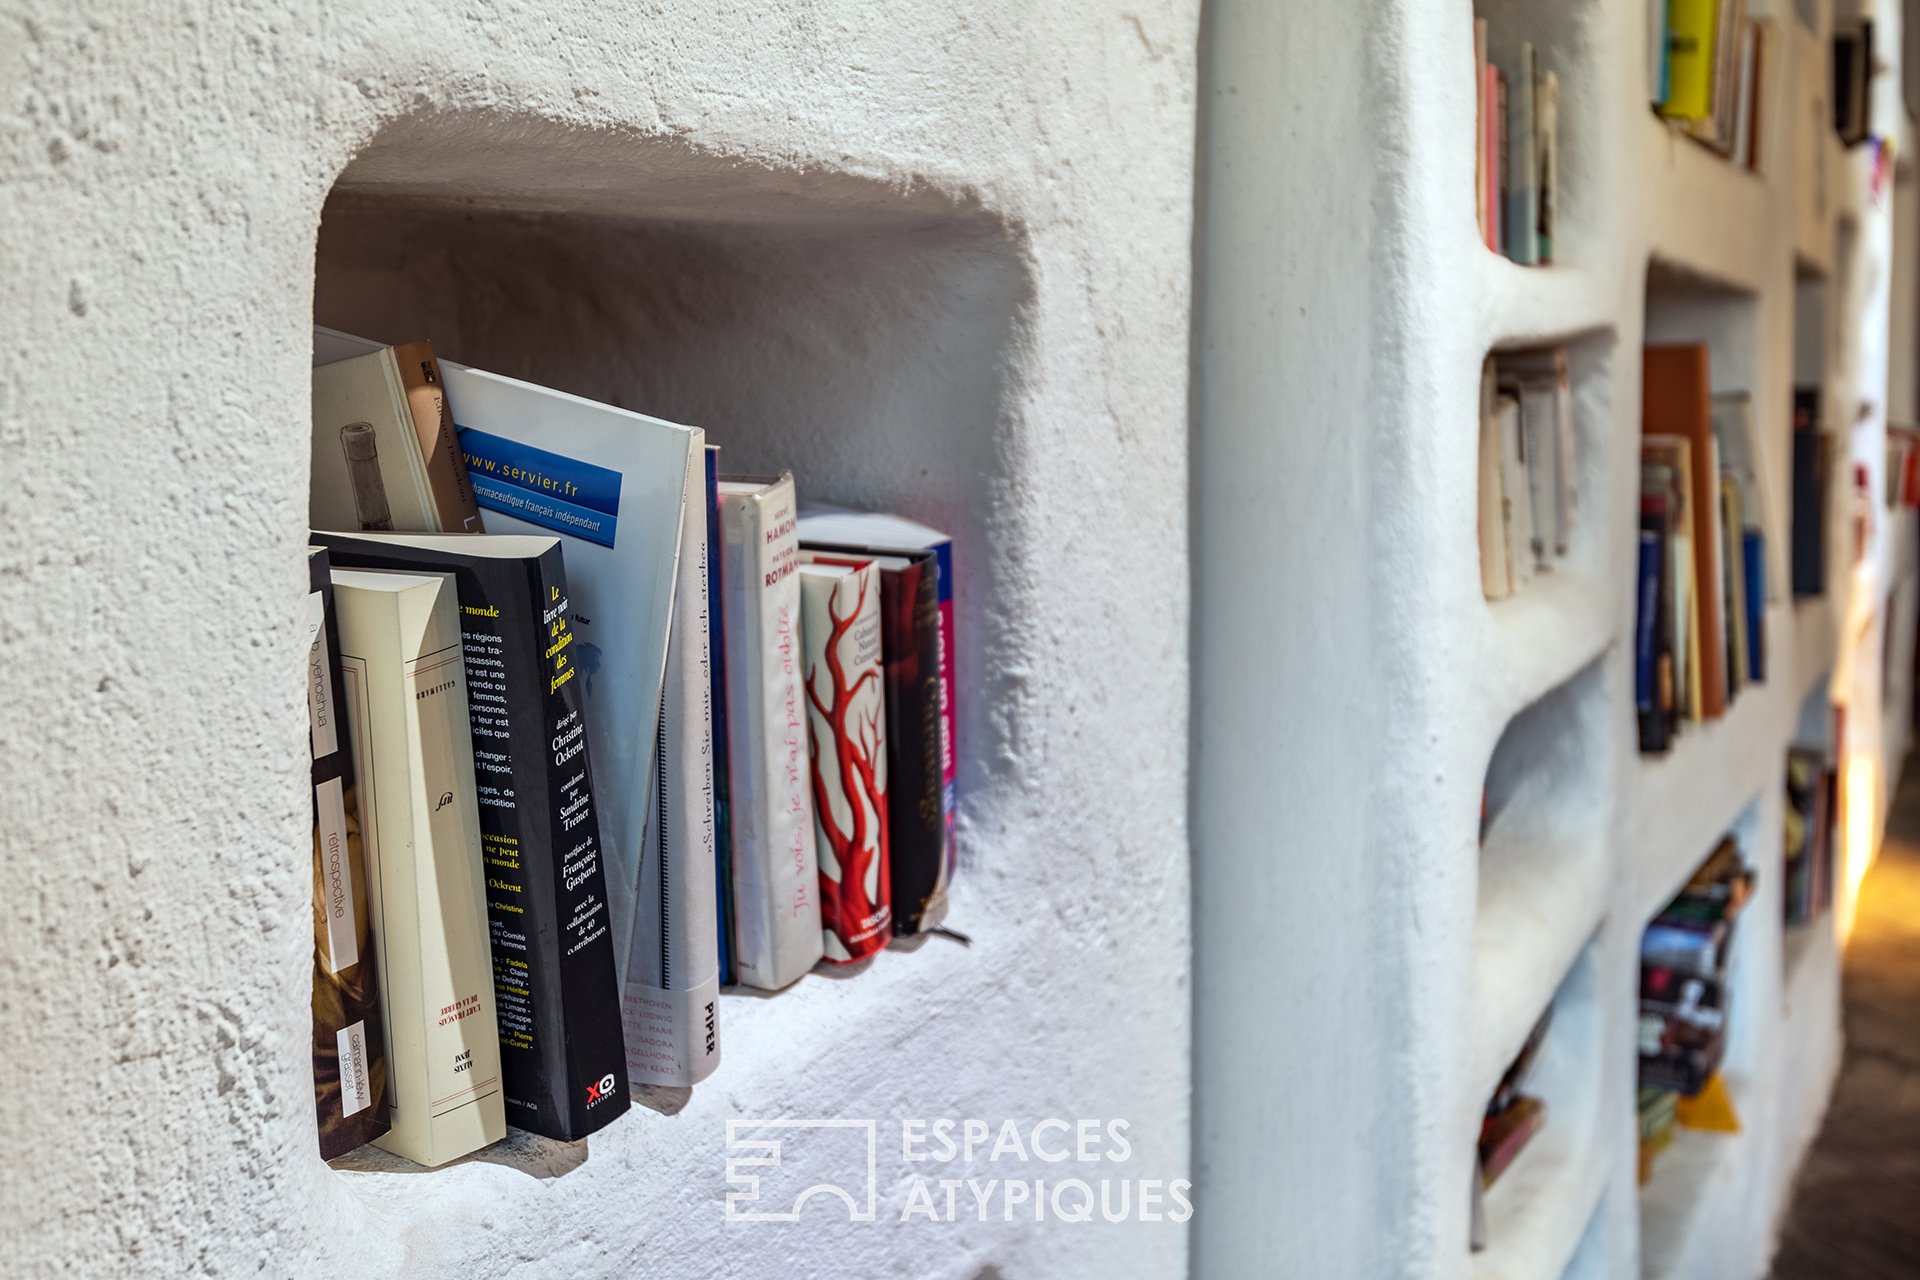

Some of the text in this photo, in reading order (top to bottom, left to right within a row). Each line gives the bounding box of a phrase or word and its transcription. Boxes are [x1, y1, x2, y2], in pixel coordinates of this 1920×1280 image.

[472, 484, 600, 532] harmaceutique français indépendant
[766, 516, 796, 544] HAMON
[772, 546, 794, 564] PATRICK
[765, 558, 800, 588] ROTMAN
[551, 586, 560, 601] Le
[465, 604, 500, 618] monde
[543, 596, 568, 624] livre noir
[551, 621, 559, 638] de
[559, 616, 566, 631] la
[700, 609, 708, 634] ich
[472, 632, 502, 643] régions
[778, 604, 793, 675] oublié
[545, 632, 573, 659] condition
[556, 653, 567, 670] des
[700, 643, 709, 678] oder
[475, 669, 488, 678] est
[490, 671, 505, 679] une
[550, 666, 575, 695] femmes
[416, 680, 456, 700] GALLIMARD
[468, 680, 494, 690] vende
[310, 658, 328, 728] yehoshua
[473, 691, 507, 704] femmes,
[470, 704, 508, 714] personne.
[786, 684, 800, 731] pas
[478, 715, 493, 724] leur
[495, 719, 509, 727] est
[494, 730, 510, 739] que
[552, 723, 584, 752] Christine
[701, 729, 711, 755] Sie
[476, 750, 506, 763] changer
[555, 740, 584, 766] Ockrent
[482, 762, 513, 774] l'espoir,
[560, 768, 585, 793] coordonné
[503, 788, 514, 797] de
[569, 788, 579, 800] par
[480, 796, 516, 808] condition
[560, 793, 589, 820] Sandrine
[786, 794, 806, 822] je
[562, 808, 589, 832] Treiner
[486, 845, 518, 858] ne peut
[491, 858, 520, 869] monde
[562, 849, 597, 879] Françoise
[328, 832, 346, 918] rétrospective
[566, 860, 596, 892] Gaspard
[488, 878, 522, 893] Ockrent
[494, 901, 524, 914] Christine
[574, 900, 588, 913] avec
[793, 883, 812, 918] Tu
[566, 902, 603, 931] collaboration
[578, 918, 596, 937] de 40
[502, 930, 526, 942] Comité
[500, 938, 527, 951] femmes
[506, 957, 528, 970] Fadela
[509, 967, 529, 979] Claire
[502, 974, 524, 988] Delphy
[506, 984, 530, 997] Héritier
[504, 1002, 527, 1014] Limare
[624, 994, 672, 1010] BEETHOVEN
[502, 1019, 526, 1031] Rampal
[640, 1011, 673, 1024] LUDWIG
[514, 1030, 534, 1042] Pierre
[648, 1024, 673, 1036] MARIE
[704, 1001, 715, 1056] PIPER
[500, 1036, 529, 1050] eil-Curiel
[637, 1036, 674, 1050] ISADORA
[630, 1048, 675, 1062] GELLHORN
[340, 1052, 355, 1092] grasset
[650, 1064, 676, 1076] KEATS
[586, 1073, 616, 1104] XO
